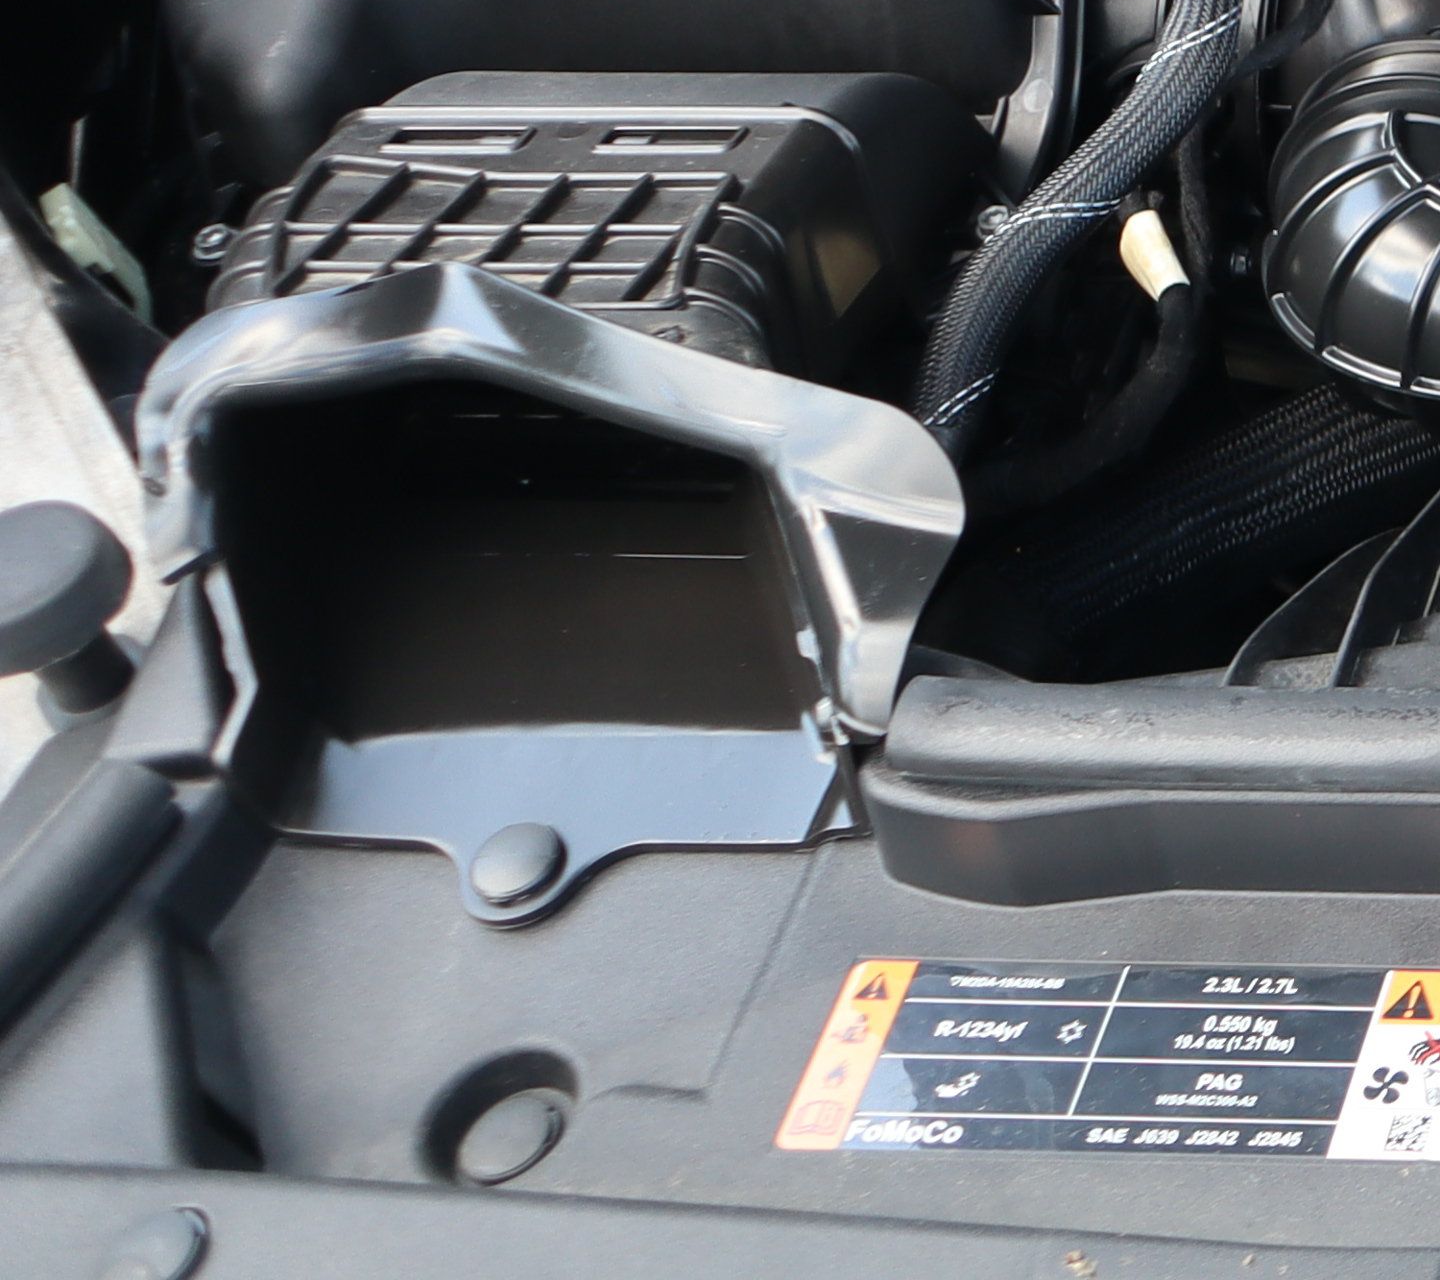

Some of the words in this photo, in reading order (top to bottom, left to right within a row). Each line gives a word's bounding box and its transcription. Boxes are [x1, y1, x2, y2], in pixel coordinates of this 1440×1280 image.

[1201, 977, 1244, 994] 2.3L
[1255, 978, 1299, 995] 2.7L
[933, 1020, 1029, 1043] R-1234yf
[1202, 1015, 1252, 1034] 0.550
[1251, 1016, 1280, 1038] kg
[1172, 1034, 1204, 1051] 19.4
[1204, 1037, 1227, 1052] oz
[1225, 1037, 1264, 1053] (1.21
[1262, 1037, 1297, 1056] lbs)
[1193, 1072, 1245, 1092] PAG
[844, 1119, 966, 1145] FoMoCo
[1085, 1126, 1131, 1144] SAE
[1132, 1127, 1181, 1145] J639
[1183, 1128, 1241, 1147] J2842
[1245, 1130, 1305, 1148] J2845
